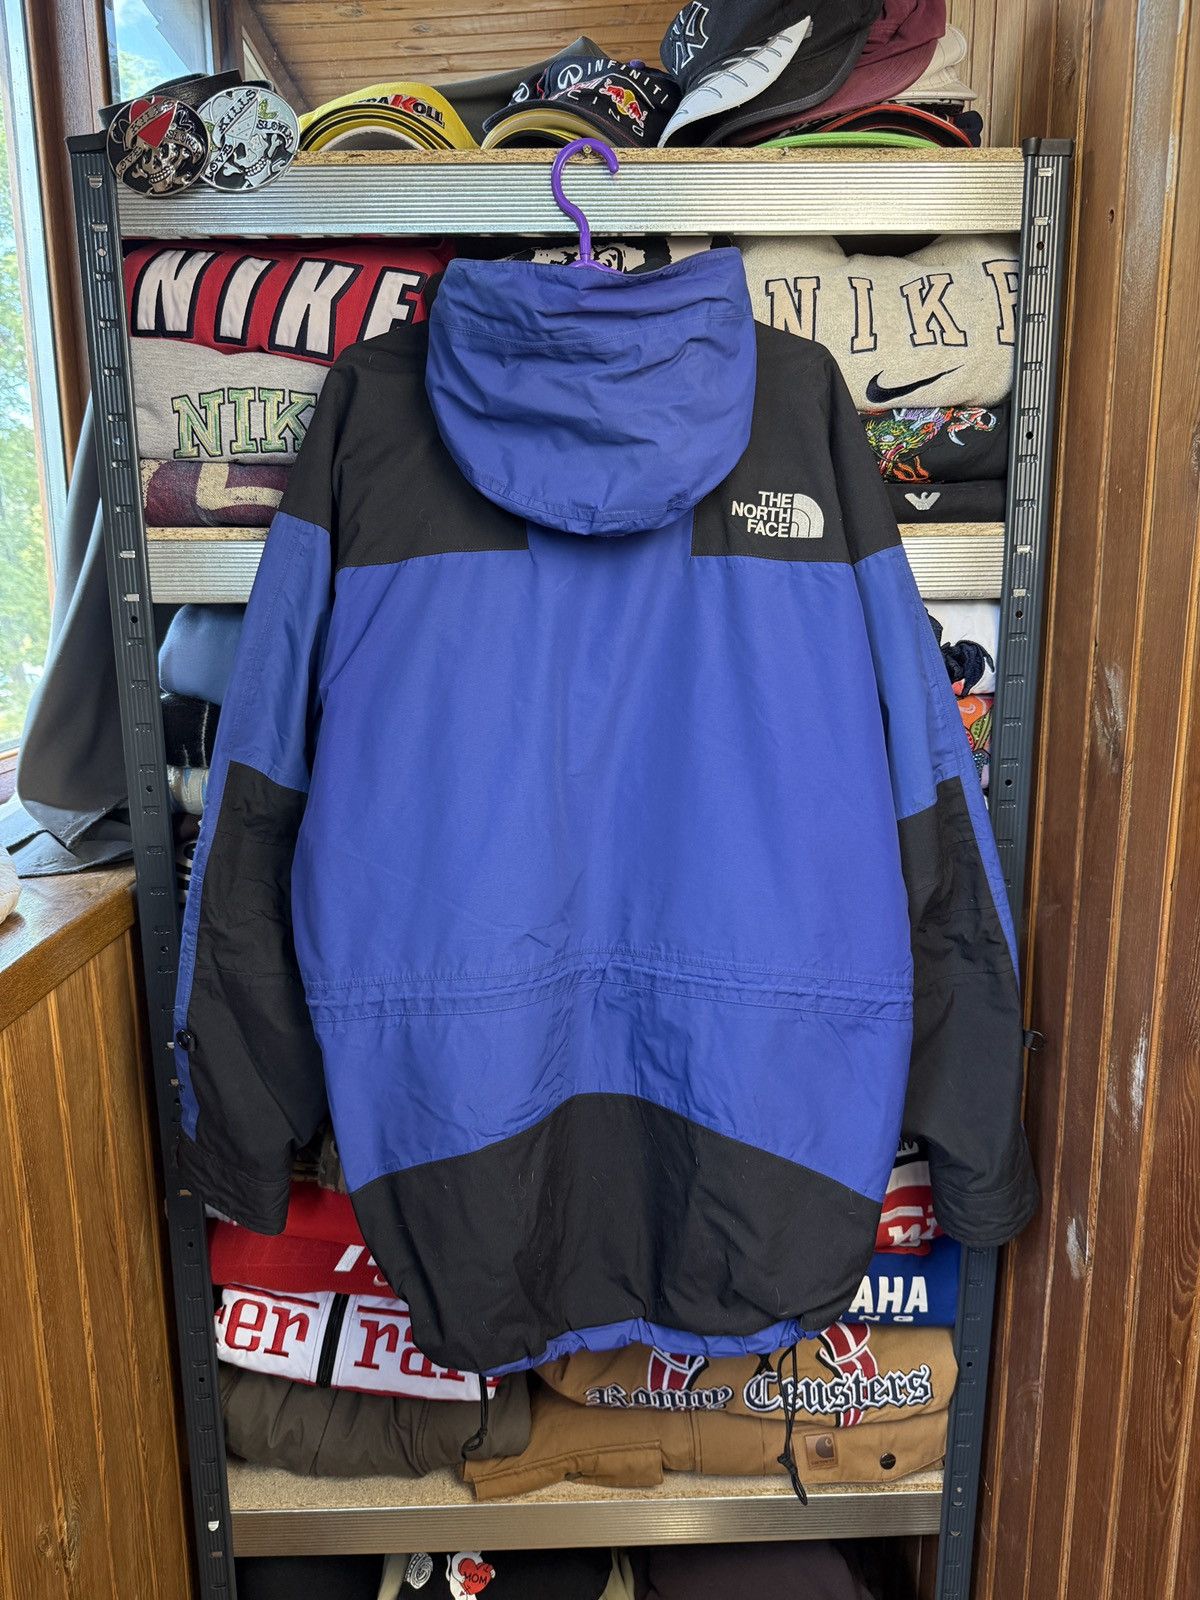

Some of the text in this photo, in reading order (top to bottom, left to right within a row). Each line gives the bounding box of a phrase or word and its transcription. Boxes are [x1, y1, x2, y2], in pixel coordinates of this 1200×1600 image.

[587, 58, 669, 105] INFINITI
[218, 89, 258, 134] KILLS
[353, 94, 446, 128] AKOLL
[256, 119, 294, 145] SLOWLY
[204, 143, 234, 181] LOVE
[731, 500, 791, 523] NORTH
[758, 490, 793, 508] THE
[747, 518, 790, 538] FACE
[464, 1571, 488, 1585] MOM
